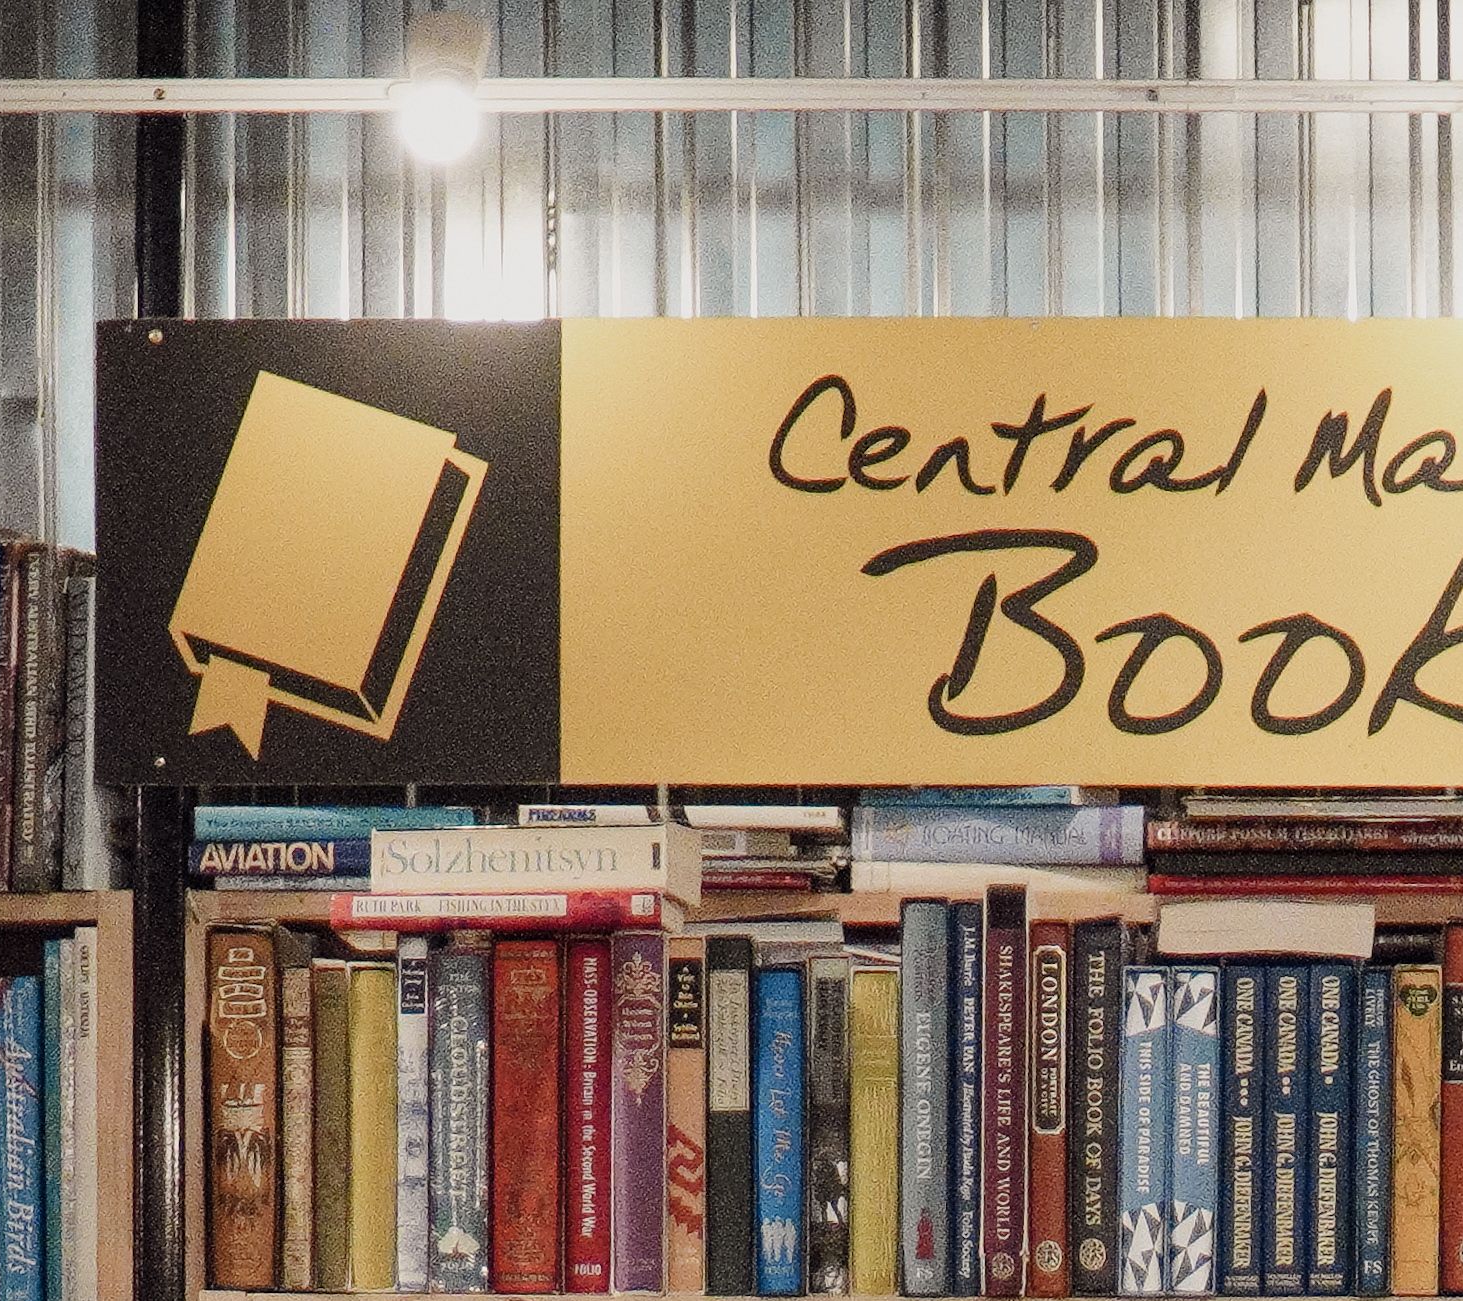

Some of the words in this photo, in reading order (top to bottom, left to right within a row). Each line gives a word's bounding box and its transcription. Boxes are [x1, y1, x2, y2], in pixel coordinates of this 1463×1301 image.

[769, 375, 1261, 500] Central
[200, 842, 335, 874] AVIATION
[384, 838, 619, 877] Solzhenitsyn
[1086, 952, 1104, 999] THE
[1319, 974, 1339, 1009] ONE
[995, 944, 1013, 1083] SHAKESPEARE'S
[1038, 962, 1059, 1061] LONDON
[1086, 1009, 1104, 1070] FOLIO
[1136, 1041, 1153, 1070] THIS
[1319, 1010, 1338, 1074] CANADA
[445, 1015, 472, 1202] CLOUDSTREET
[995, 1088, 1012, 1127] LIFE
[1086, 1078, 1104, 1135] BOOK
[1136, 1073, 1153, 1104] SIDE
[0, 1041, 35, 1194] Australian
[1136, 1107, 1152, 1126] OF
[1317, 1110, 1337, 1150] JOHN
[995, 1132, 1012, 1171] AND
[1085, 1141, 1103, 1167] OF
[1136, 1127, 1152, 1194] PARADISE
[995, 1177, 1012, 1241] WORLD
[1084, 1174, 1103, 1225] DAYS
[1316, 1167, 1337, 1266] DIEFENBAKER
[6, 1201, 34, 1274] Birds
